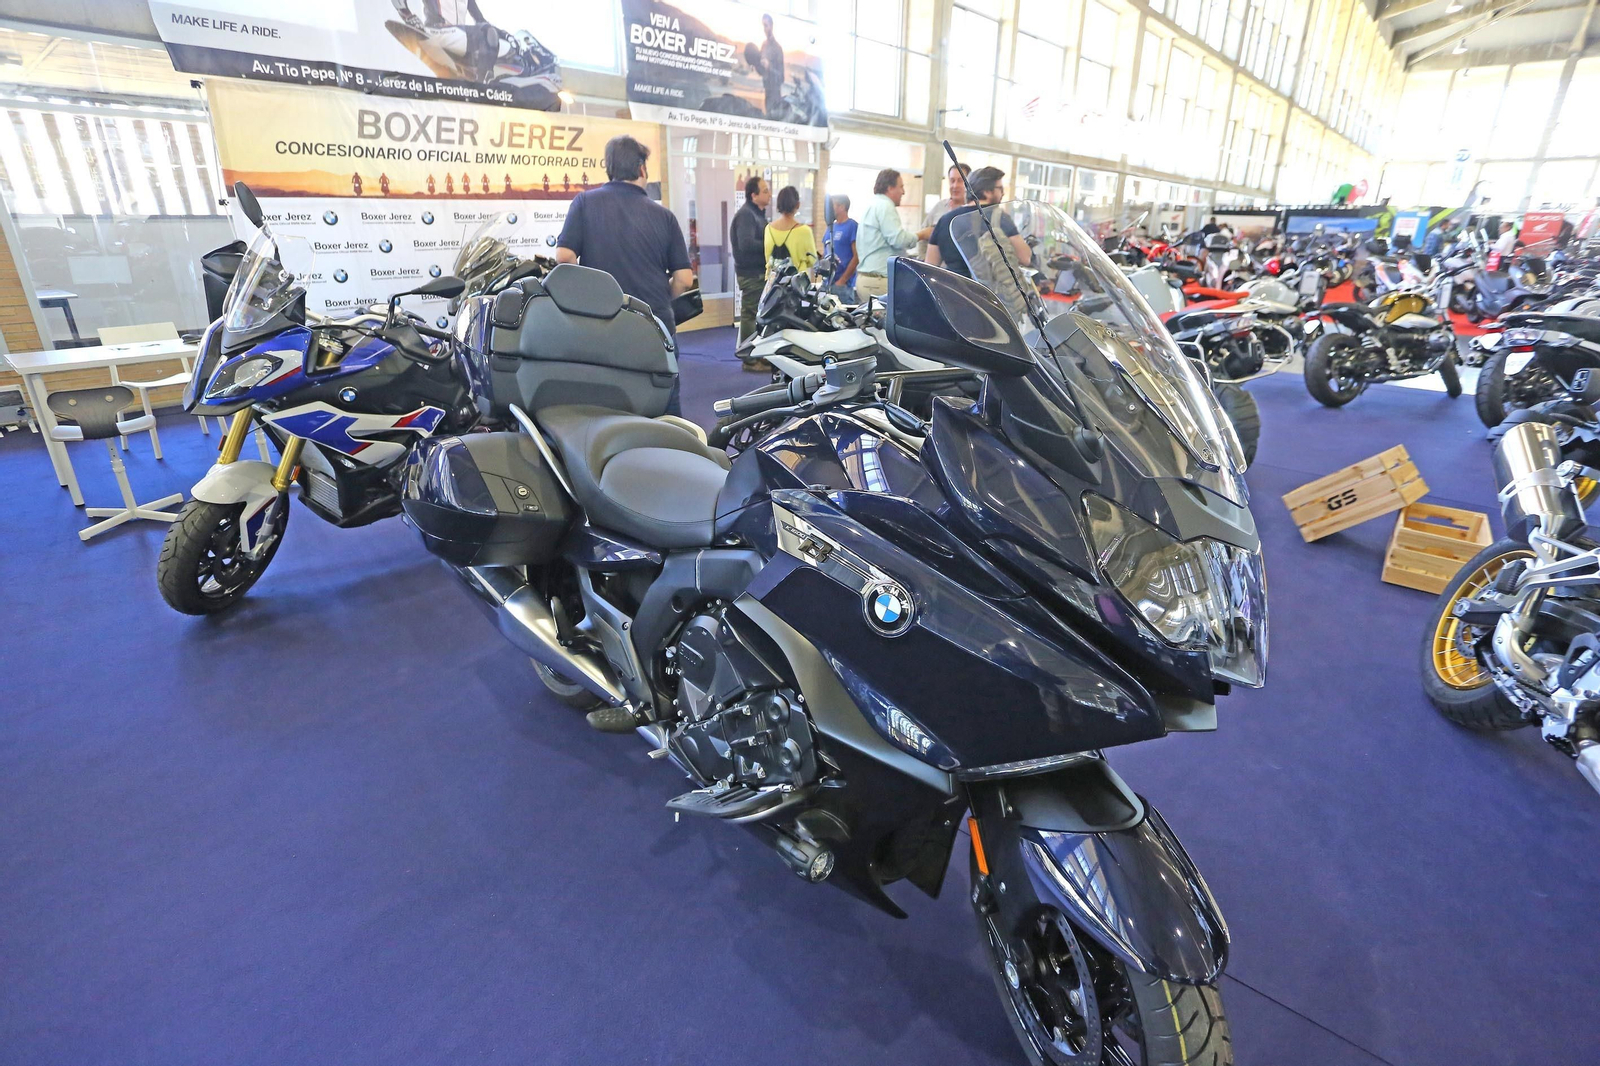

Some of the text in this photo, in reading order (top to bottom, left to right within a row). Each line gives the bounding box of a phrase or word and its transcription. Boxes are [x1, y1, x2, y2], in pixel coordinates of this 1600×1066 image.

[171, 13, 281, 39] MAKE LIFE A RIDE.
[650, 12, 680, 31] VEN A
[630, 23, 738, 64] BOXER JEREZ.
[252, 60, 274, 75] Av.
[301, 65, 339, 82] Pepe,
[355, 73, 364, 85] 8
[409, 81, 422, 92] de
[424, 82, 434, 93] la
[436, 83, 479, 98] Frontera
[486, 88, 513, 102] Cádiz
[634, 83, 652, 93] MAKE
[653, 86, 665, 95] LIFE
[357, 108, 585, 152] BOXER JEREZ
[275, 140, 412, 161] CONCESIONARIO
[417, 149, 471, 164] OFICIAL
[475, 152, 507, 165] BMW
[510, 154, 579, 168] MOTORRAD
[582, 157, 597, 168] EN
[262, 212, 312, 221] oxer Jerez
[361, 212, 412, 221] Boxer Jerez
[453, 212, 492, 220] Boxer Jer
[314, 241, 369, 250] Boxer Jerez
[413, 239, 460, 248] Boxer Jerez
[370, 267, 420, 277] Boxer Jerez
[325, 297, 378, 307] Boxer Jerez
[1327, 488, 1358, 511] GS
[877, 585, 910, 611] BMW
